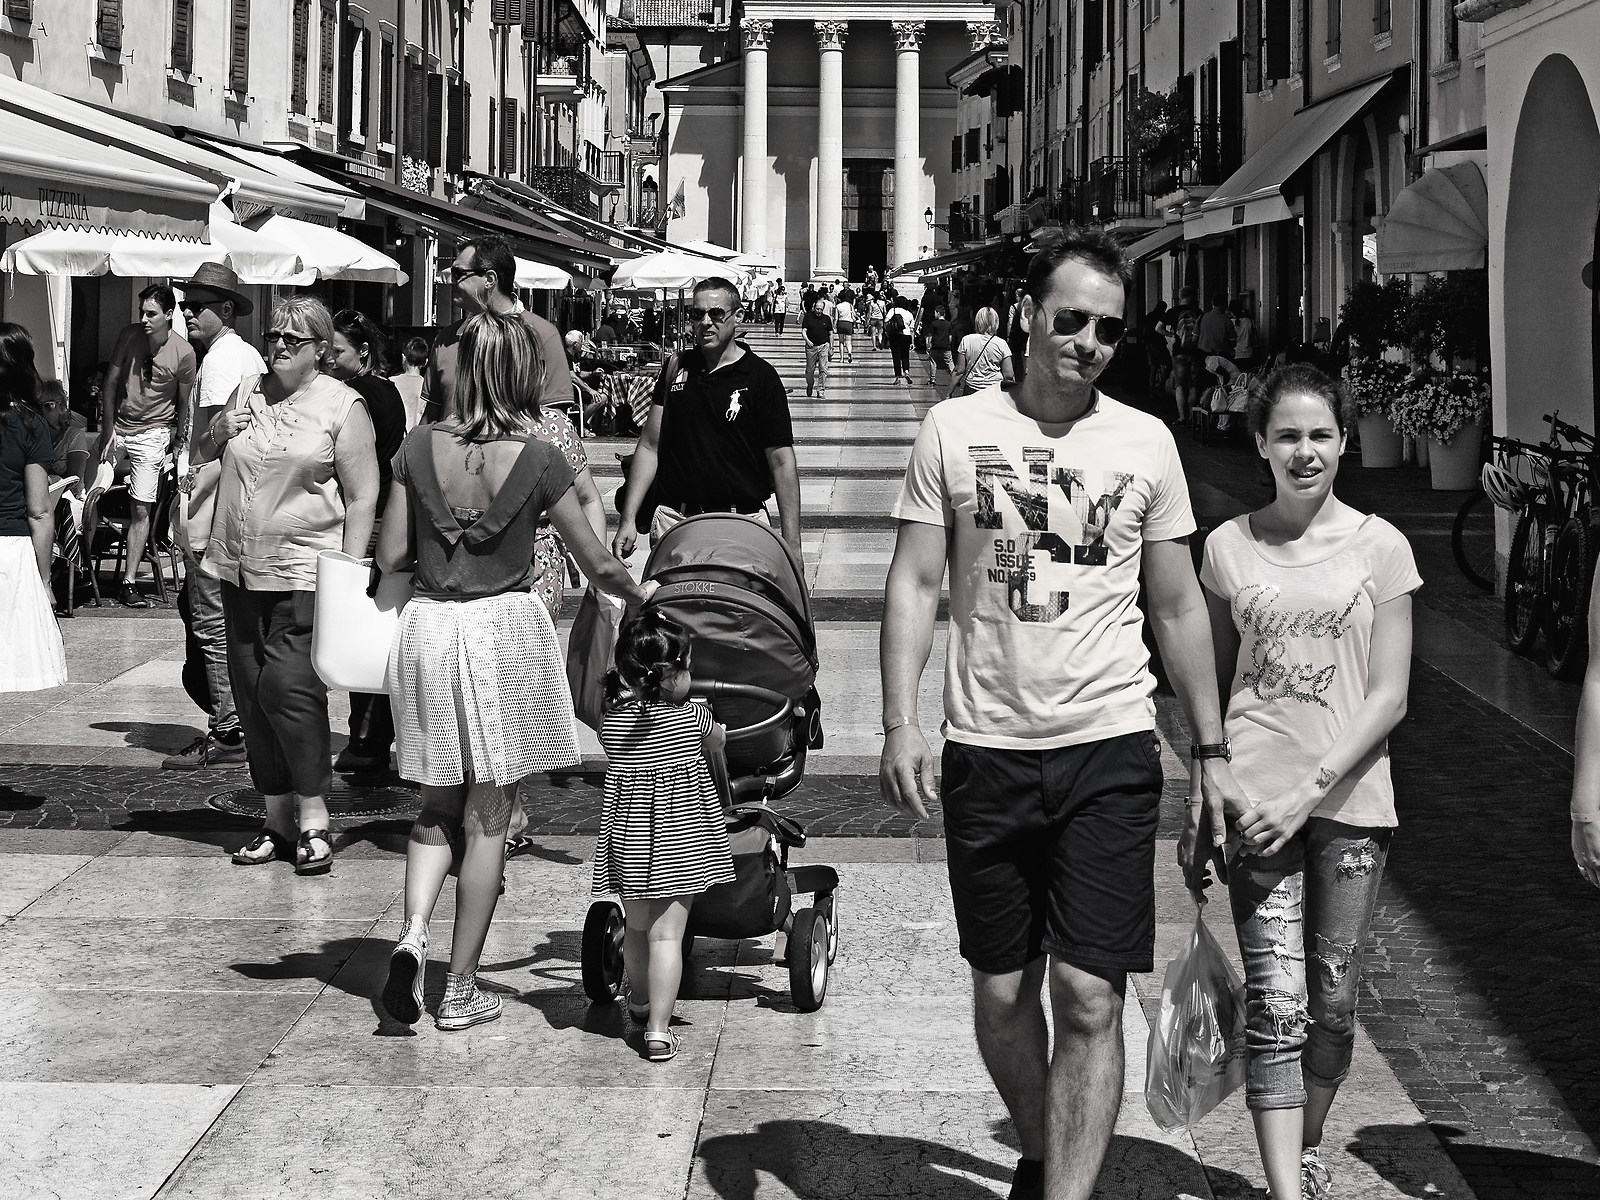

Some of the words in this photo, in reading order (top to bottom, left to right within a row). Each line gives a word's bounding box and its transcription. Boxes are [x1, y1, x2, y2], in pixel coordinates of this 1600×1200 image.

[38, 187, 90, 221] PIZZERIA
[995, 553, 1035, 569] ISSUE
[674, 581, 715, 594] STOKKE
